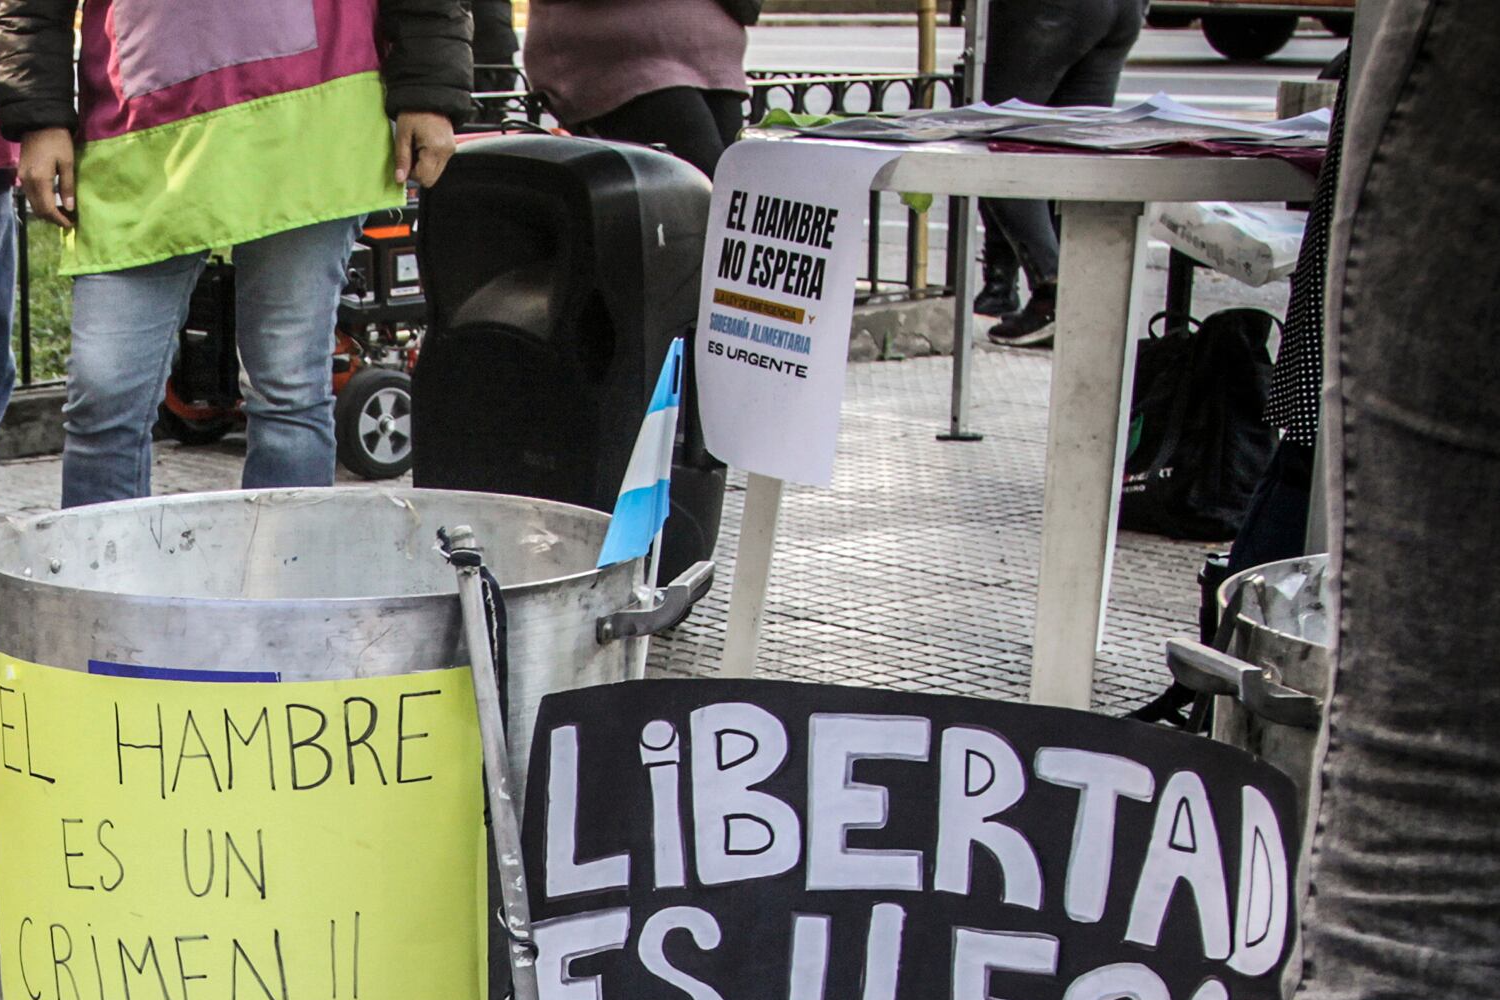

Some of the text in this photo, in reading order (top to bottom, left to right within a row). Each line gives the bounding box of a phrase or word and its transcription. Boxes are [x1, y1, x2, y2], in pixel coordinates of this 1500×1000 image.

[726, 189, 838, 249] EL HAMBRE
[717, 237, 826, 300] NO ESPERA
[750, 323, 811, 354] ALIMENTARIA
[809, 316, 816, 324] Y
[708, 341, 808, 378] ES URGENTE
[0, 686, 441, 799] EL HAMBRE
[62, 818, 265, 899] ES UN
